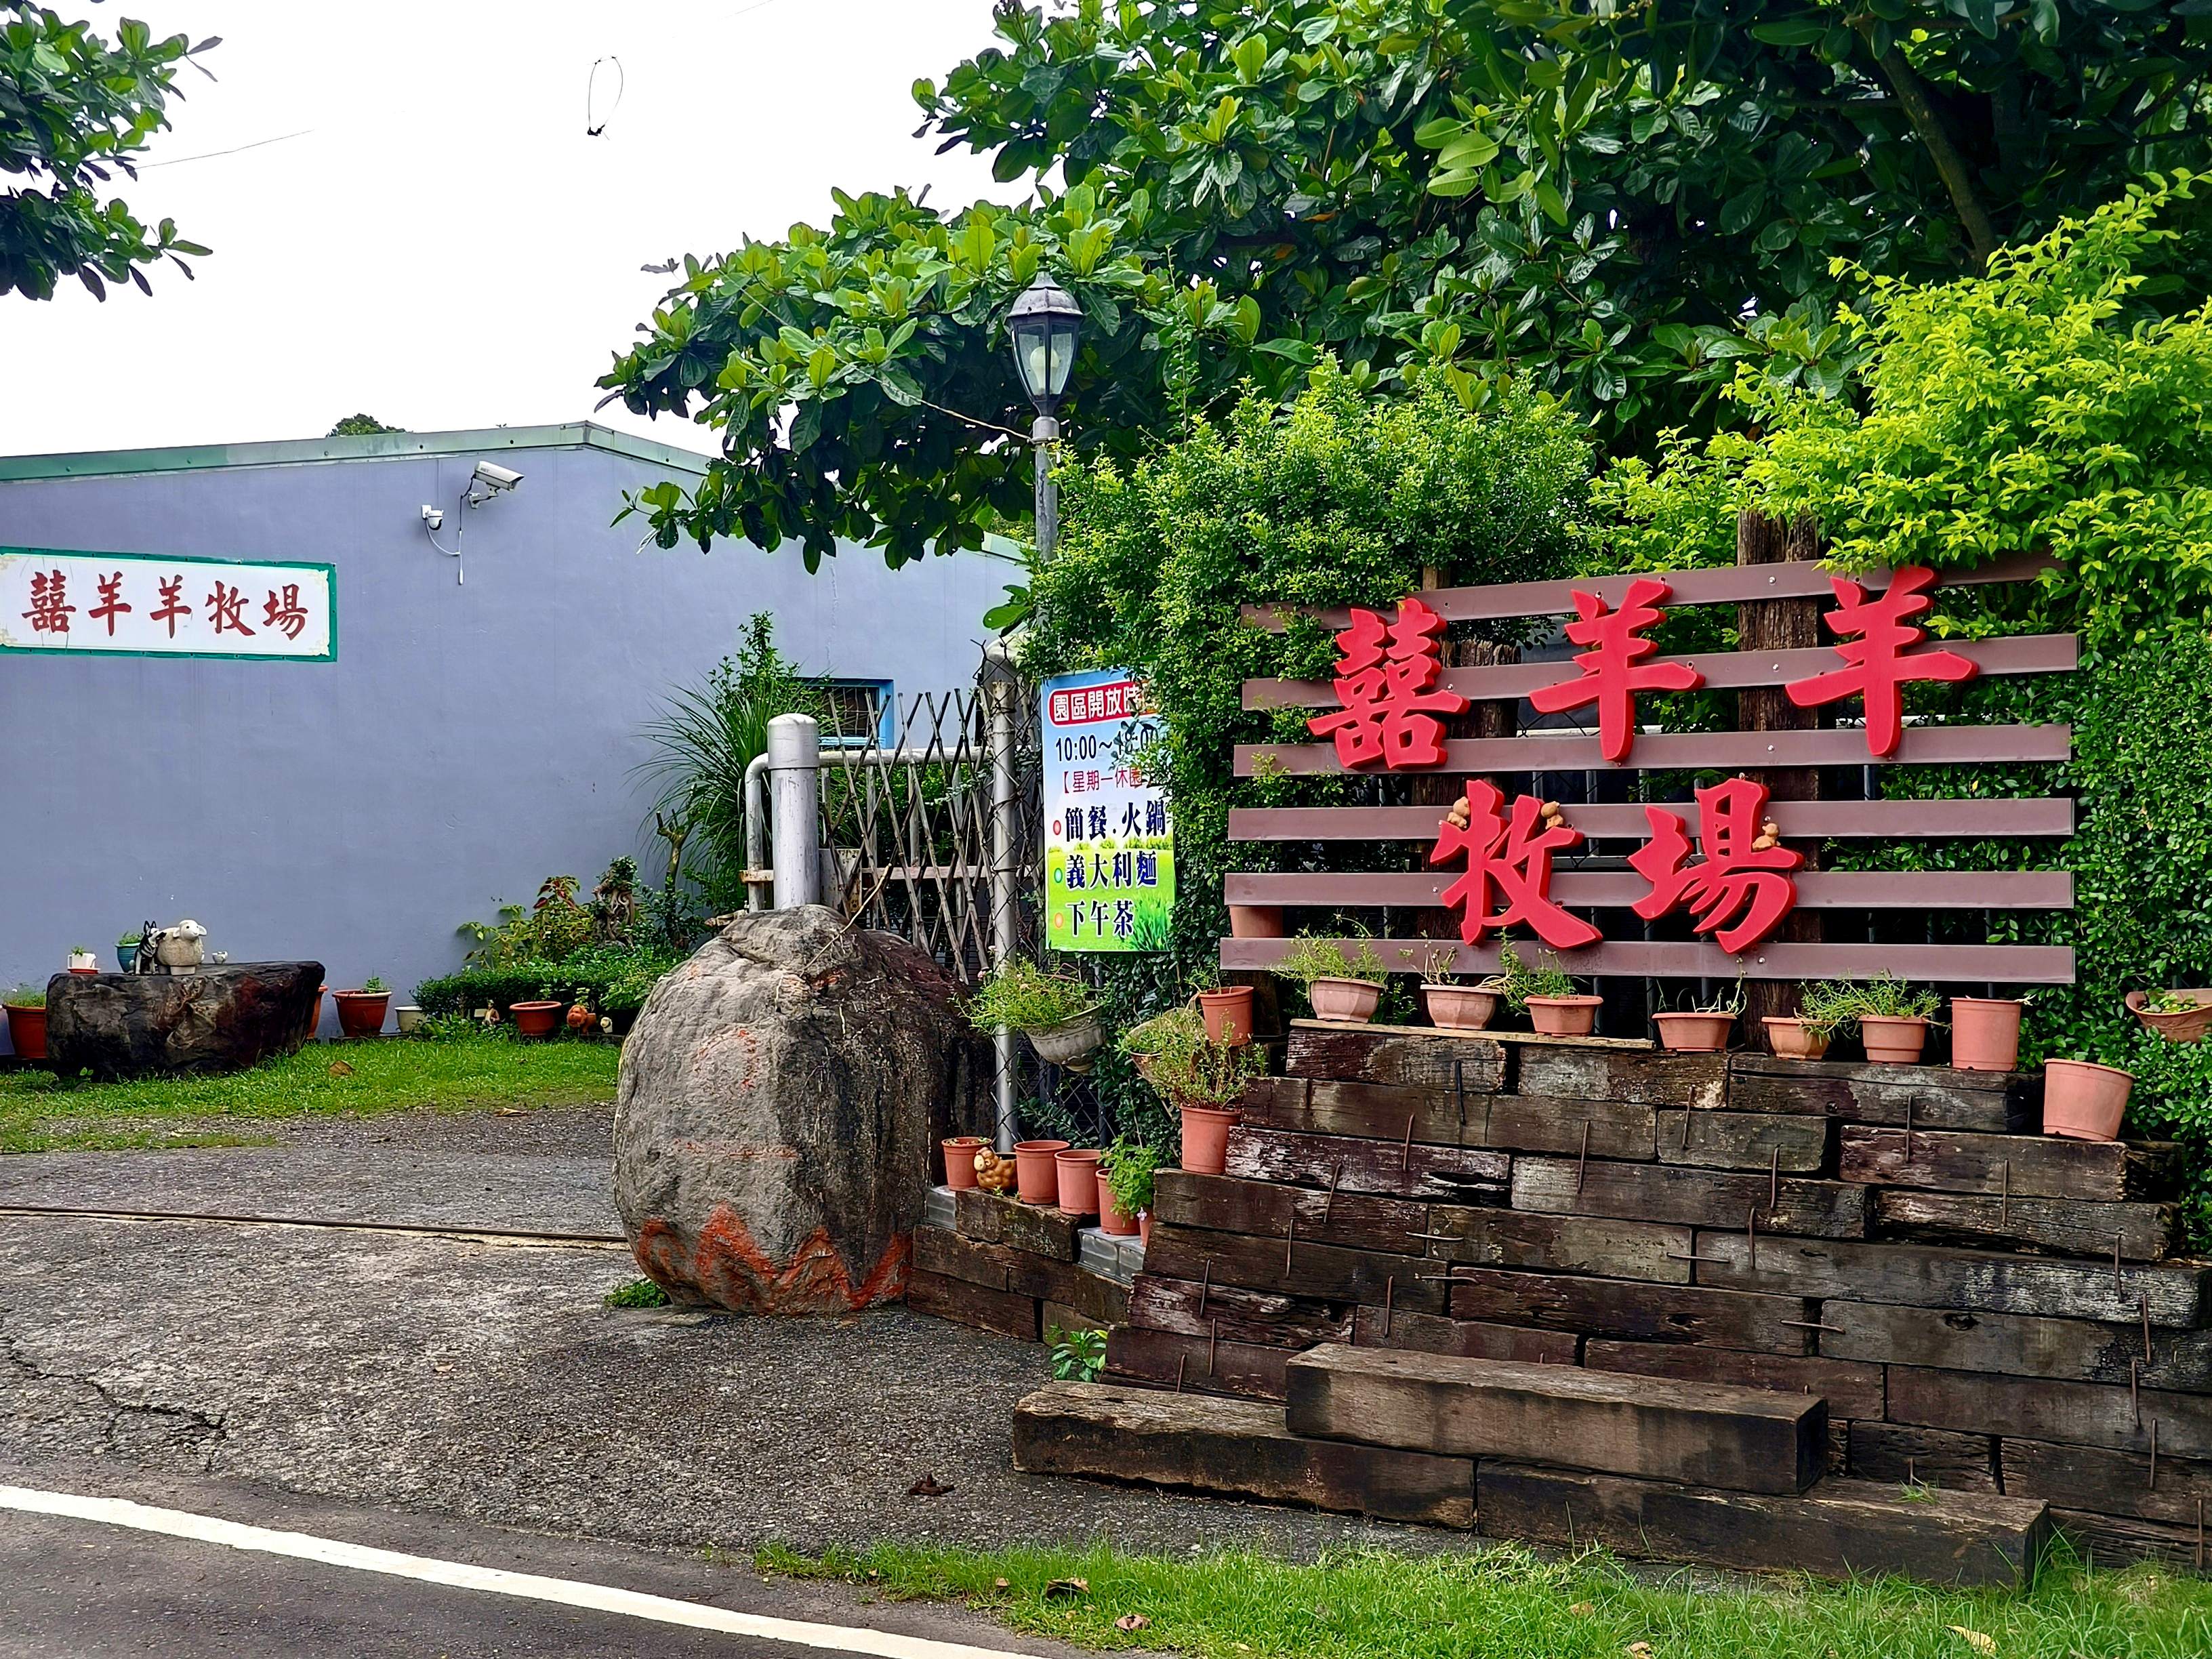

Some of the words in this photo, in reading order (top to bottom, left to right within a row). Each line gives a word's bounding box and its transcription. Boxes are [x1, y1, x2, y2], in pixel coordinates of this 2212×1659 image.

[22, 569, 308, 640] 囍羊羊牧場
[1307, 565, 1978, 770] 囍羊羊
[1066, 851, 1157, 889] 義大利麵
[1430, 777, 1805, 954] 牧場
[1067, 900, 1134, 936] 下午茶
